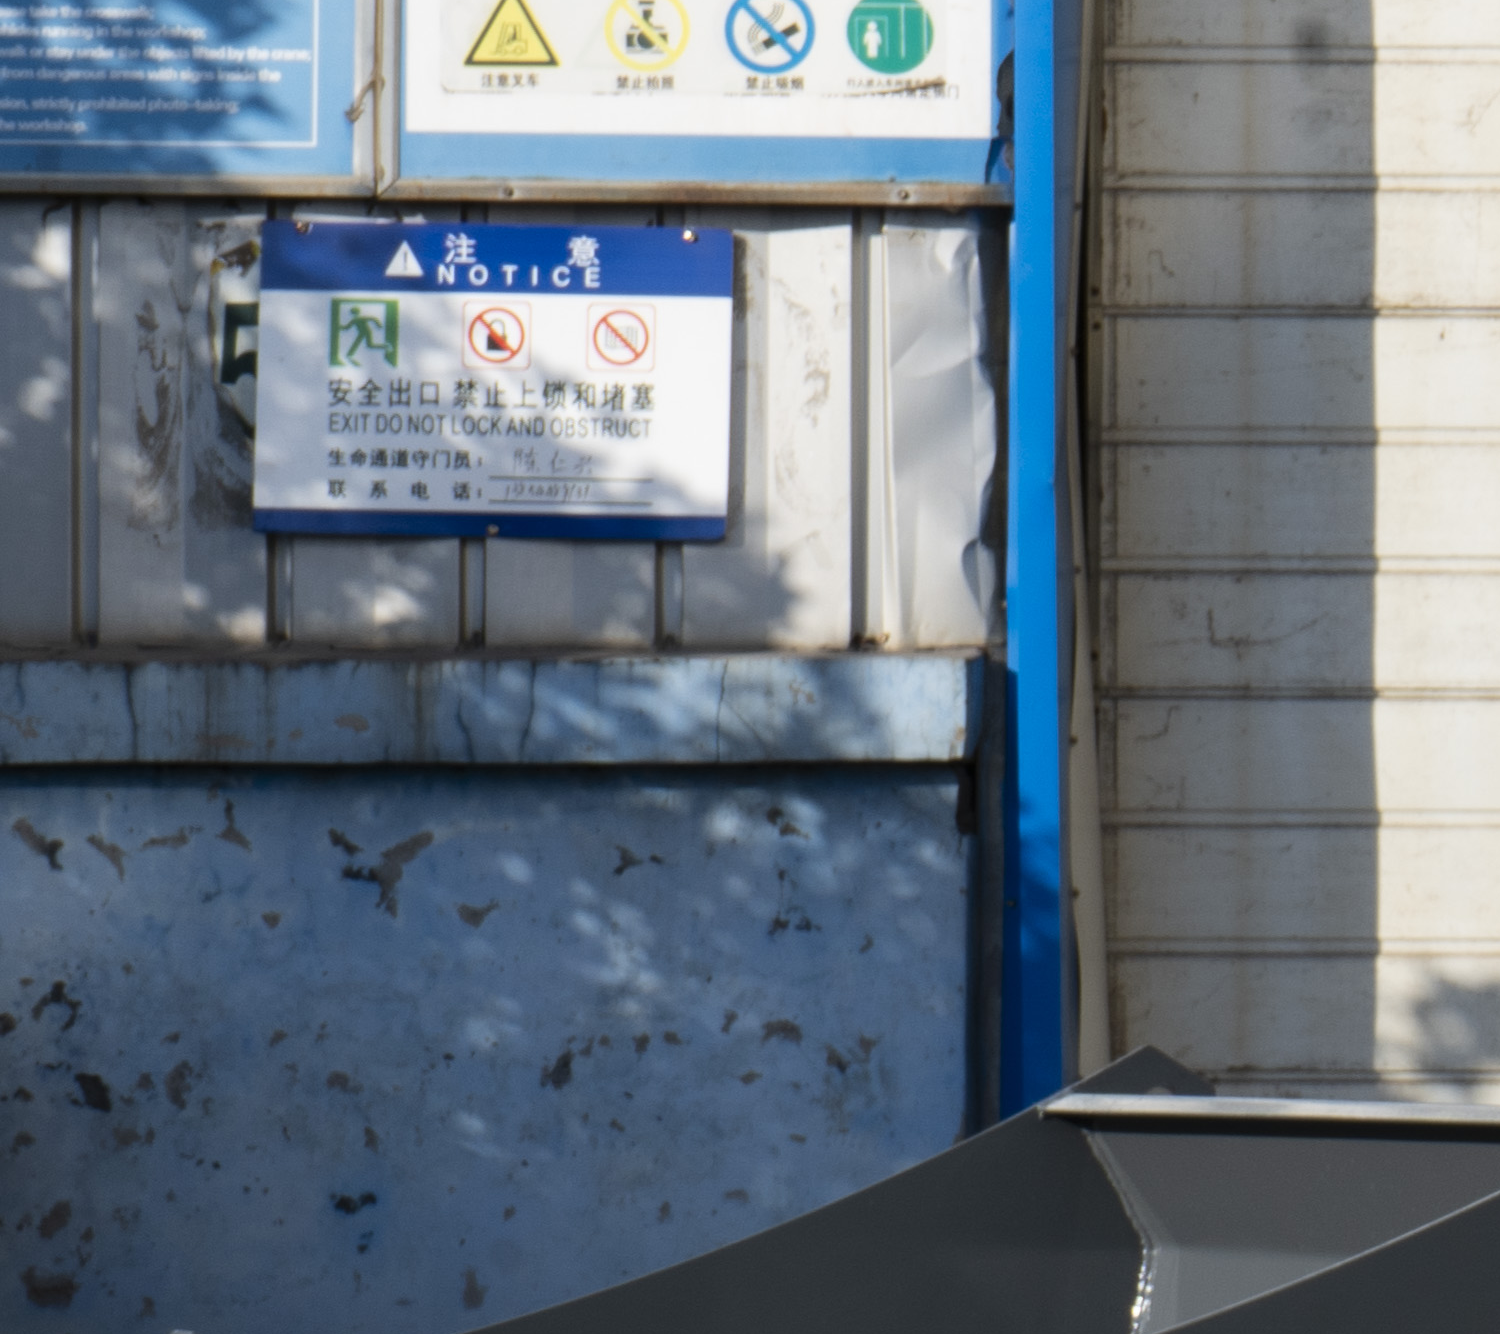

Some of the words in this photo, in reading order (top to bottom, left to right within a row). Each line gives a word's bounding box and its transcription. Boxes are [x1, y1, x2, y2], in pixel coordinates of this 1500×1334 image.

[438, 264, 602, 289] NOTICE
[328, 378, 440, 409] 安全出口
[453, 379, 655, 412] 禁止上锁和堵塞
[329, 413, 371, 435] EXIT
[376, 413, 404, 435] DO
[408, 413, 446, 436] NOT
[452, 414, 502, 437] LOCK
[506, 415, 545, 438] AND
[550, 416, 653, 440] OBSTRUCT
